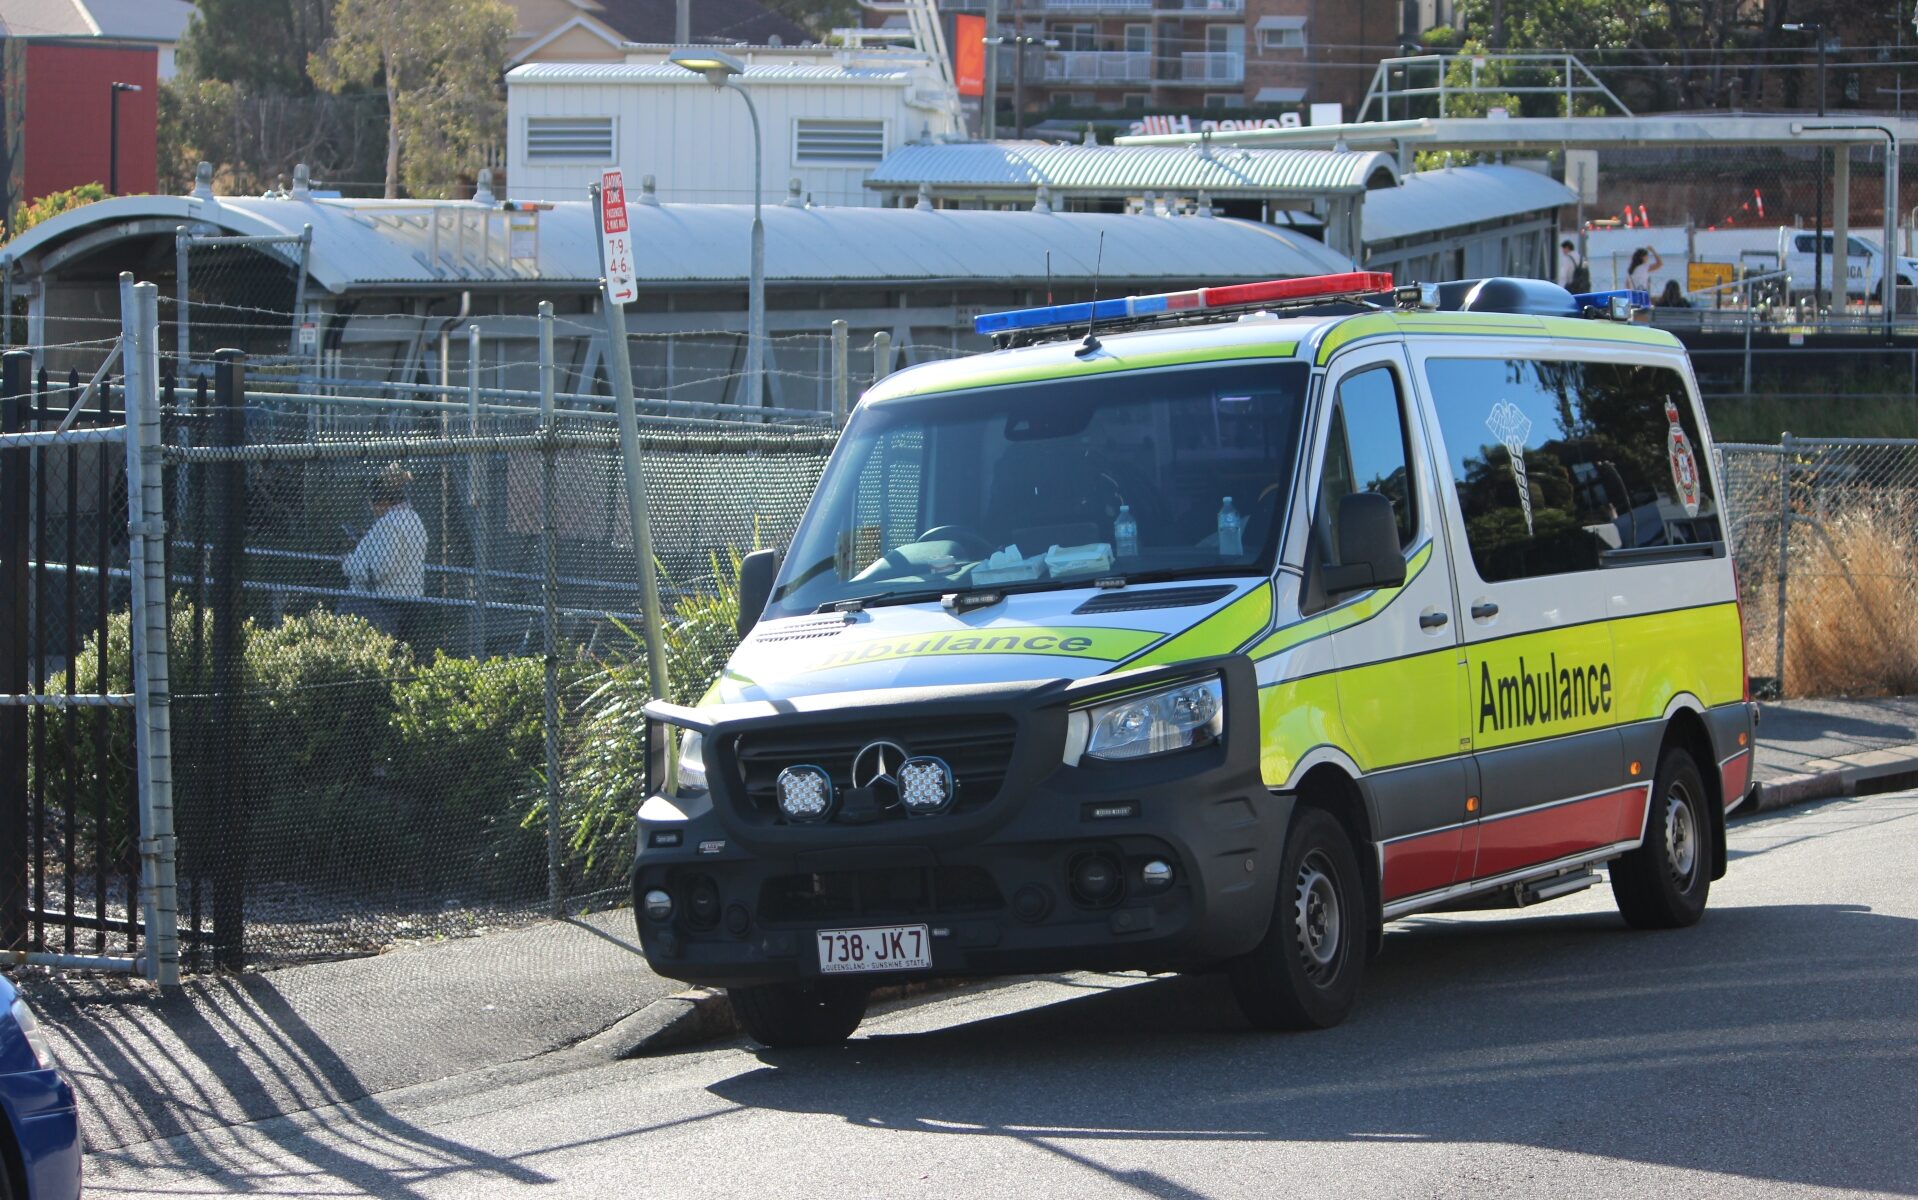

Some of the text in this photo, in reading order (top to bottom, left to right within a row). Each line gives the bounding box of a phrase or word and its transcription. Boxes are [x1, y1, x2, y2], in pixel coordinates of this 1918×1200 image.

[603, 174, 622, 190] LOADING
[606, 190, 621, 204] ZONE
[1479, 652, 1612, 733] Ambulance
[821, 930, 921, 963] 738 JK7
[825, 959, 925, 972] QUEENSLAND SUNSHINE STATE
